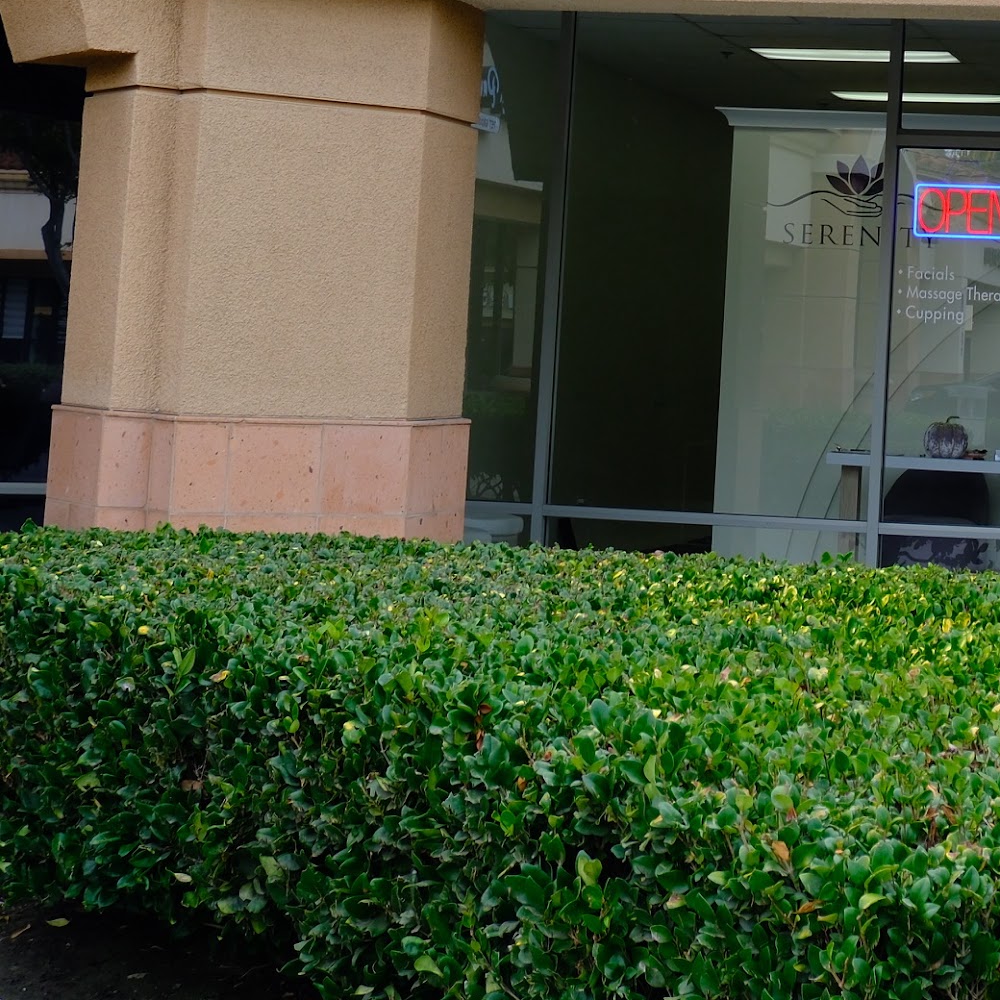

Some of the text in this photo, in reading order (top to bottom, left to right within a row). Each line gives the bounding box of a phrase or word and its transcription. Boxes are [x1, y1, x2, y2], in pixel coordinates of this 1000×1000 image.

[783, 222, 937, 249] SERENTY
[907, 265, 955, 281] Facials
[906, 286, 962, 304] Massage
[905, 305, 964, 325] Cupping
